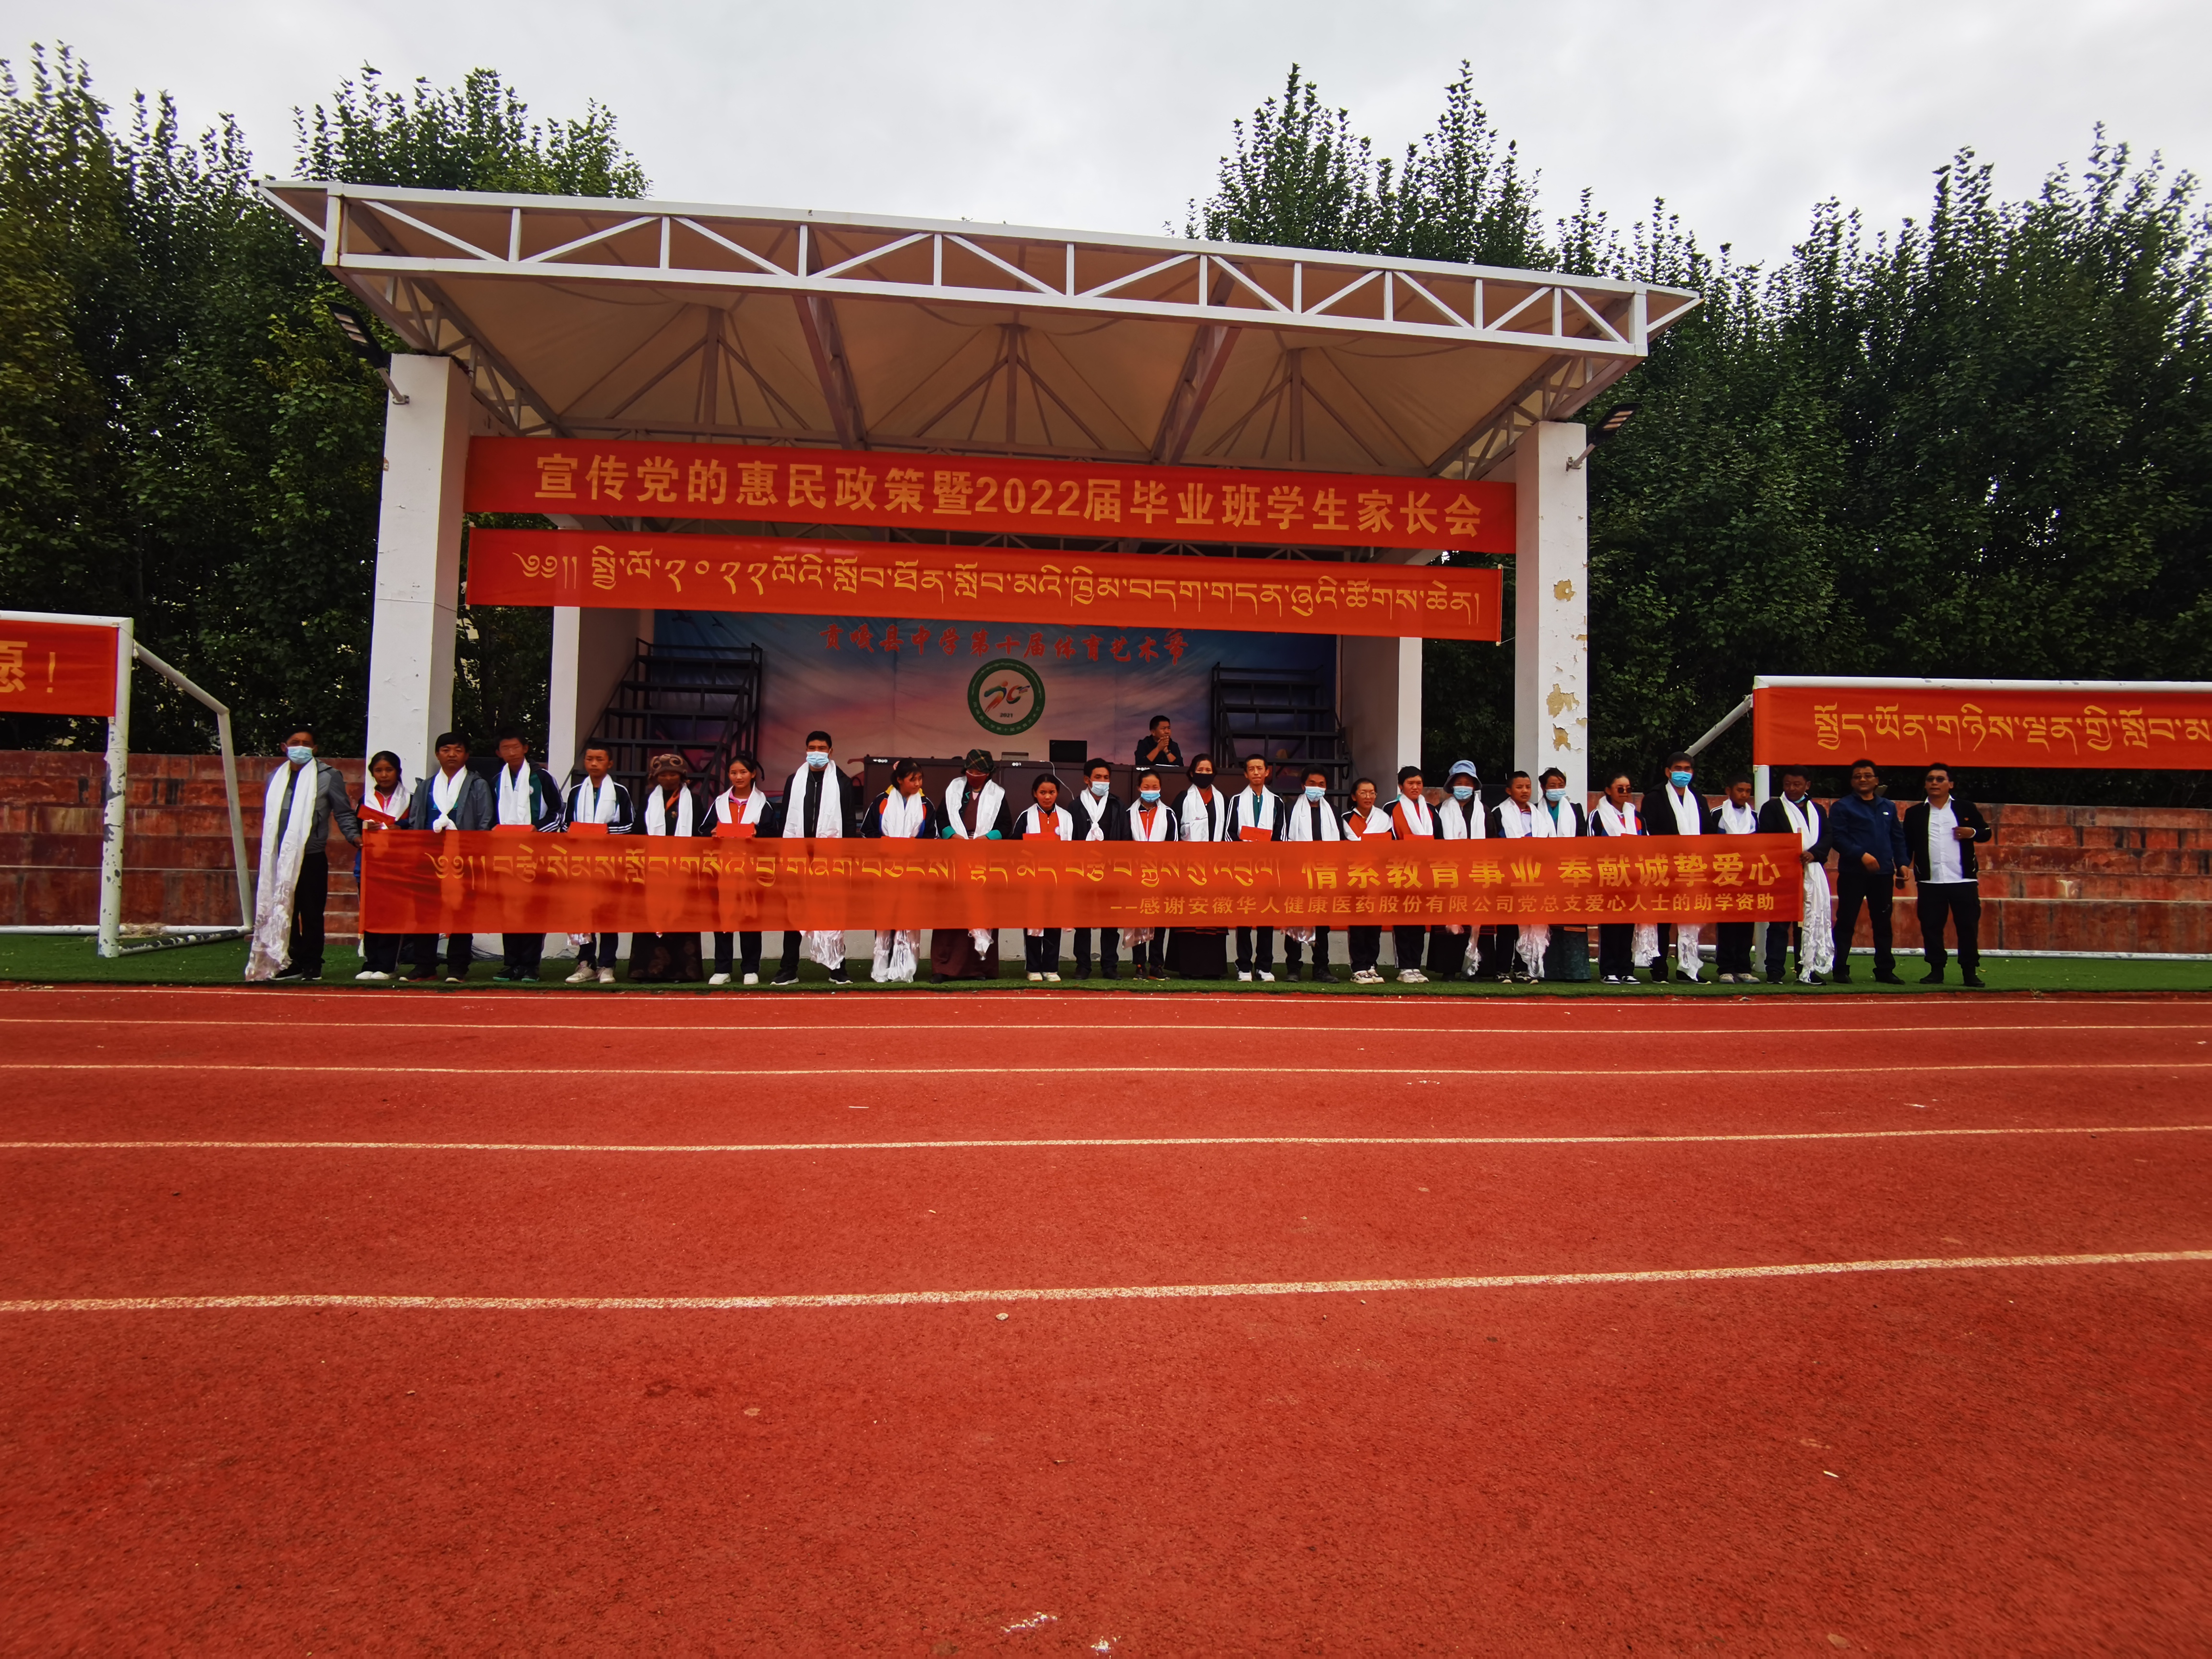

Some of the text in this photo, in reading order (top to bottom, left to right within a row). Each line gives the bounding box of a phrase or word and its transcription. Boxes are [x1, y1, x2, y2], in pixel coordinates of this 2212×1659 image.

[534, 453, 1482, 537] 宣传党的惠民政策暨2022届毕业班学生家长会
[819, 623, 1188, 666] 贡嘎县中学第十届体育艺术节
[1301, 852, 1781, 890] 情系教育事业 奉献诚挚爱心
